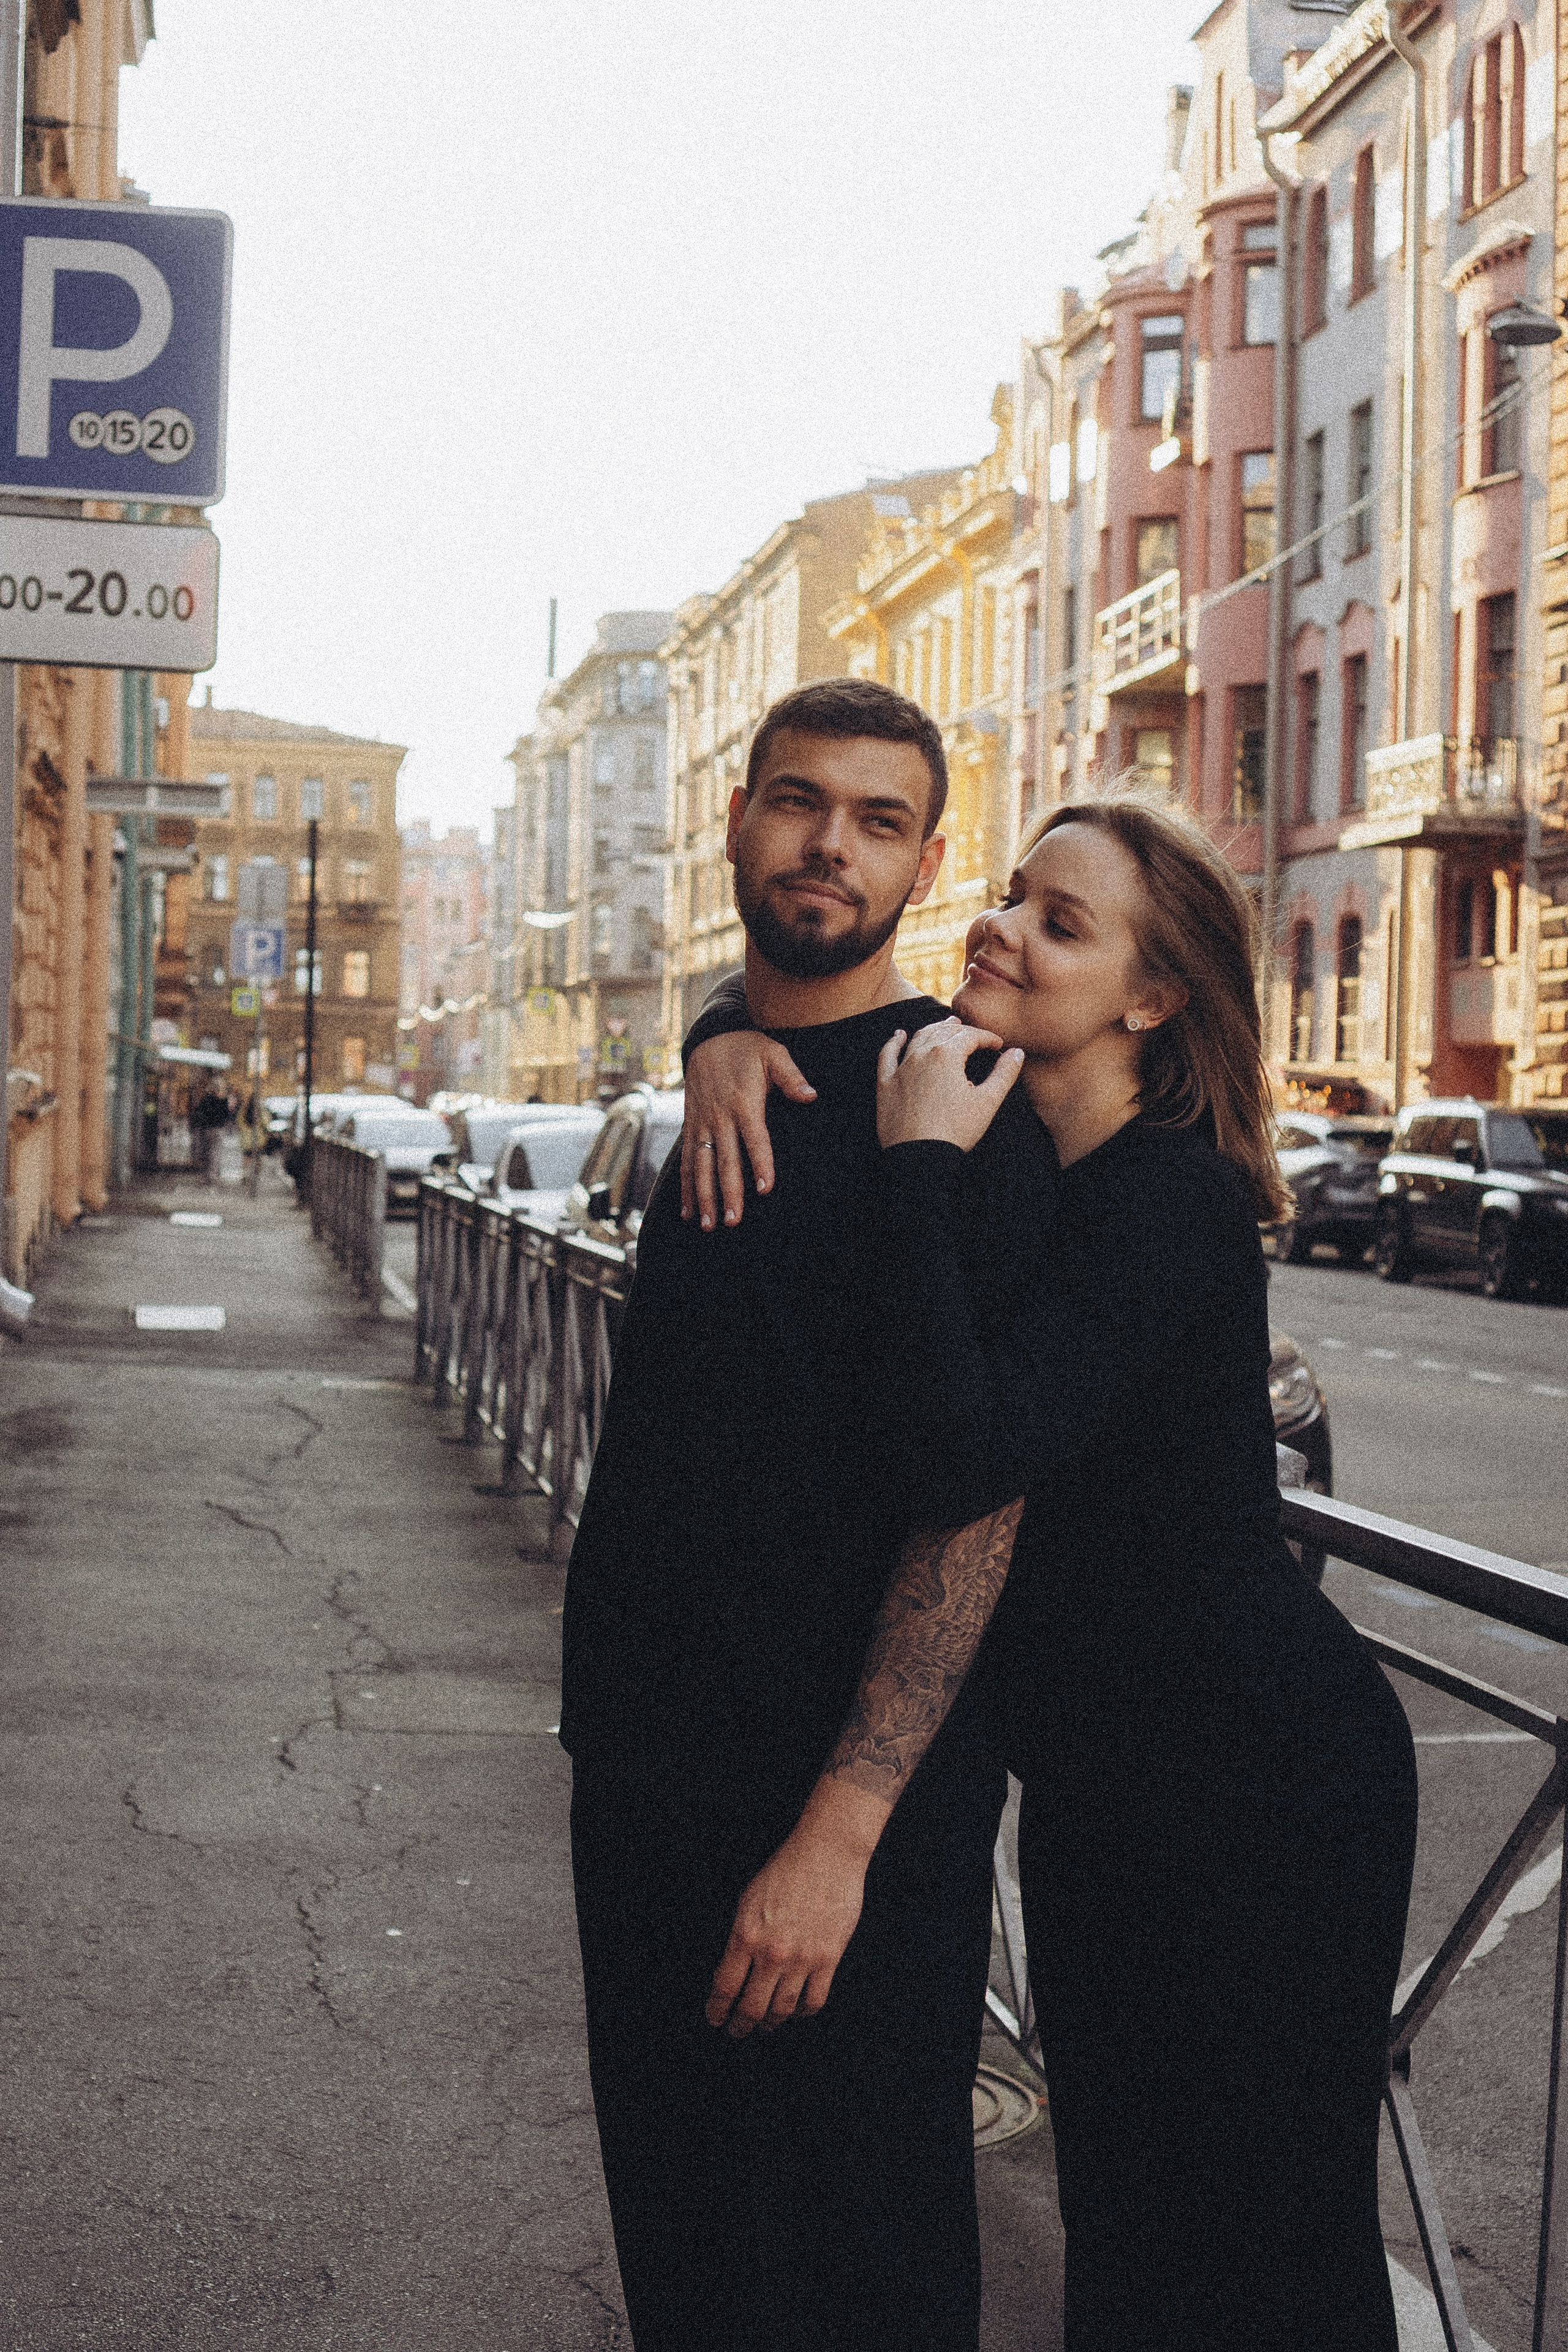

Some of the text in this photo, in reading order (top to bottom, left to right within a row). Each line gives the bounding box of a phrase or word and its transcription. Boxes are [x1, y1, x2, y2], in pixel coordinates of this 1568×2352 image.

[16, 236, 173, 458] P
[78, 419, 188, 451] 10 15 20
[0, 567, 195, 622] 00-20.00
[245, 931, 276, 969] P
